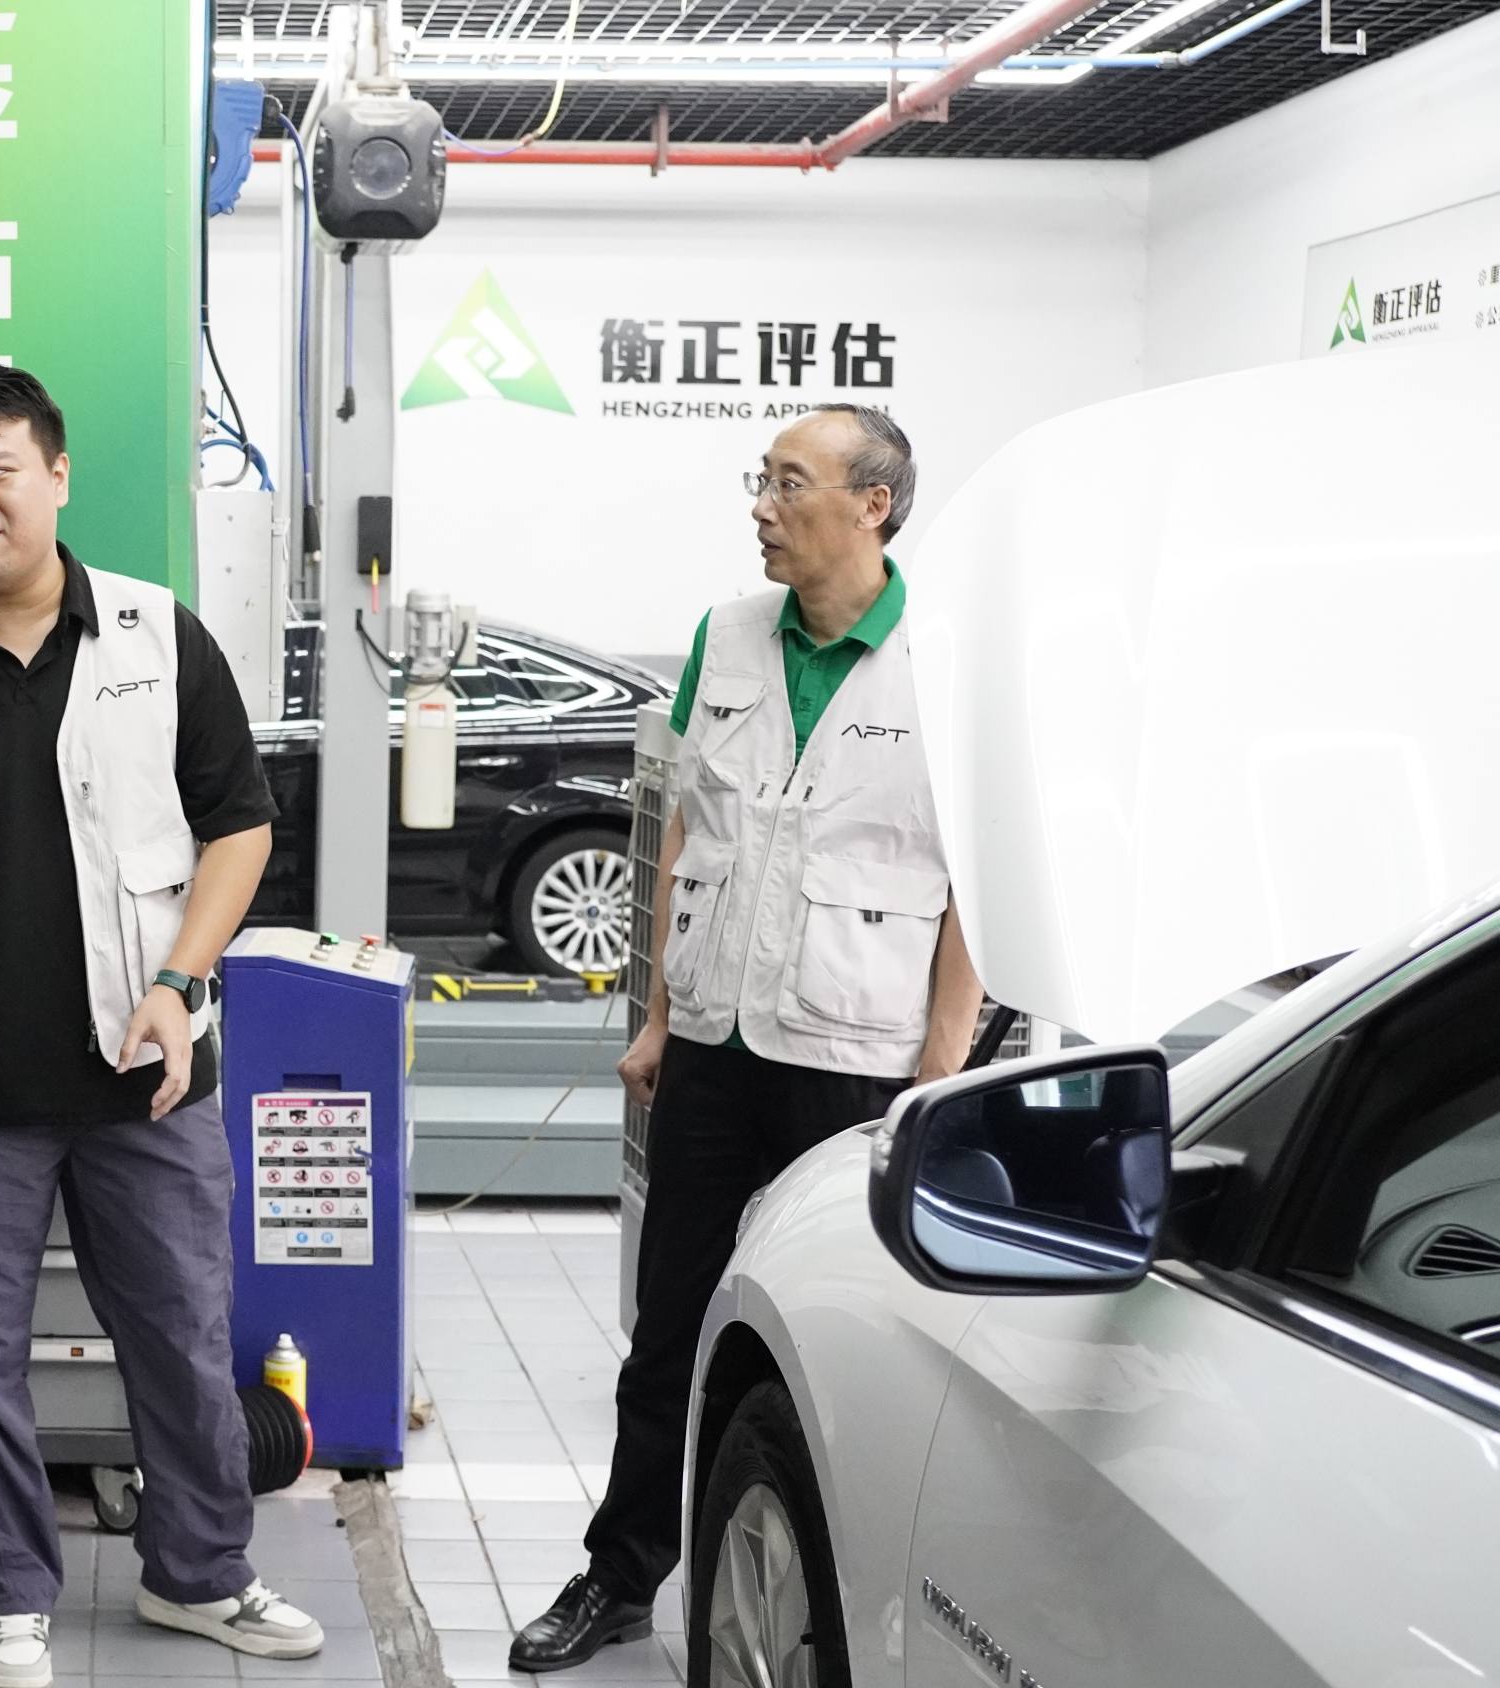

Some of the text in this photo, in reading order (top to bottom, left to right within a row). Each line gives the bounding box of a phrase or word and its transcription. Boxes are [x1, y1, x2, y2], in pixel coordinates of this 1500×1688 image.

[599, 318, 897, 388] 衡正评估
[602, 400, 753, 419] HENGZHENG
[95, 679, 161, 702] APT
[841, 723, 911, 743] APT
